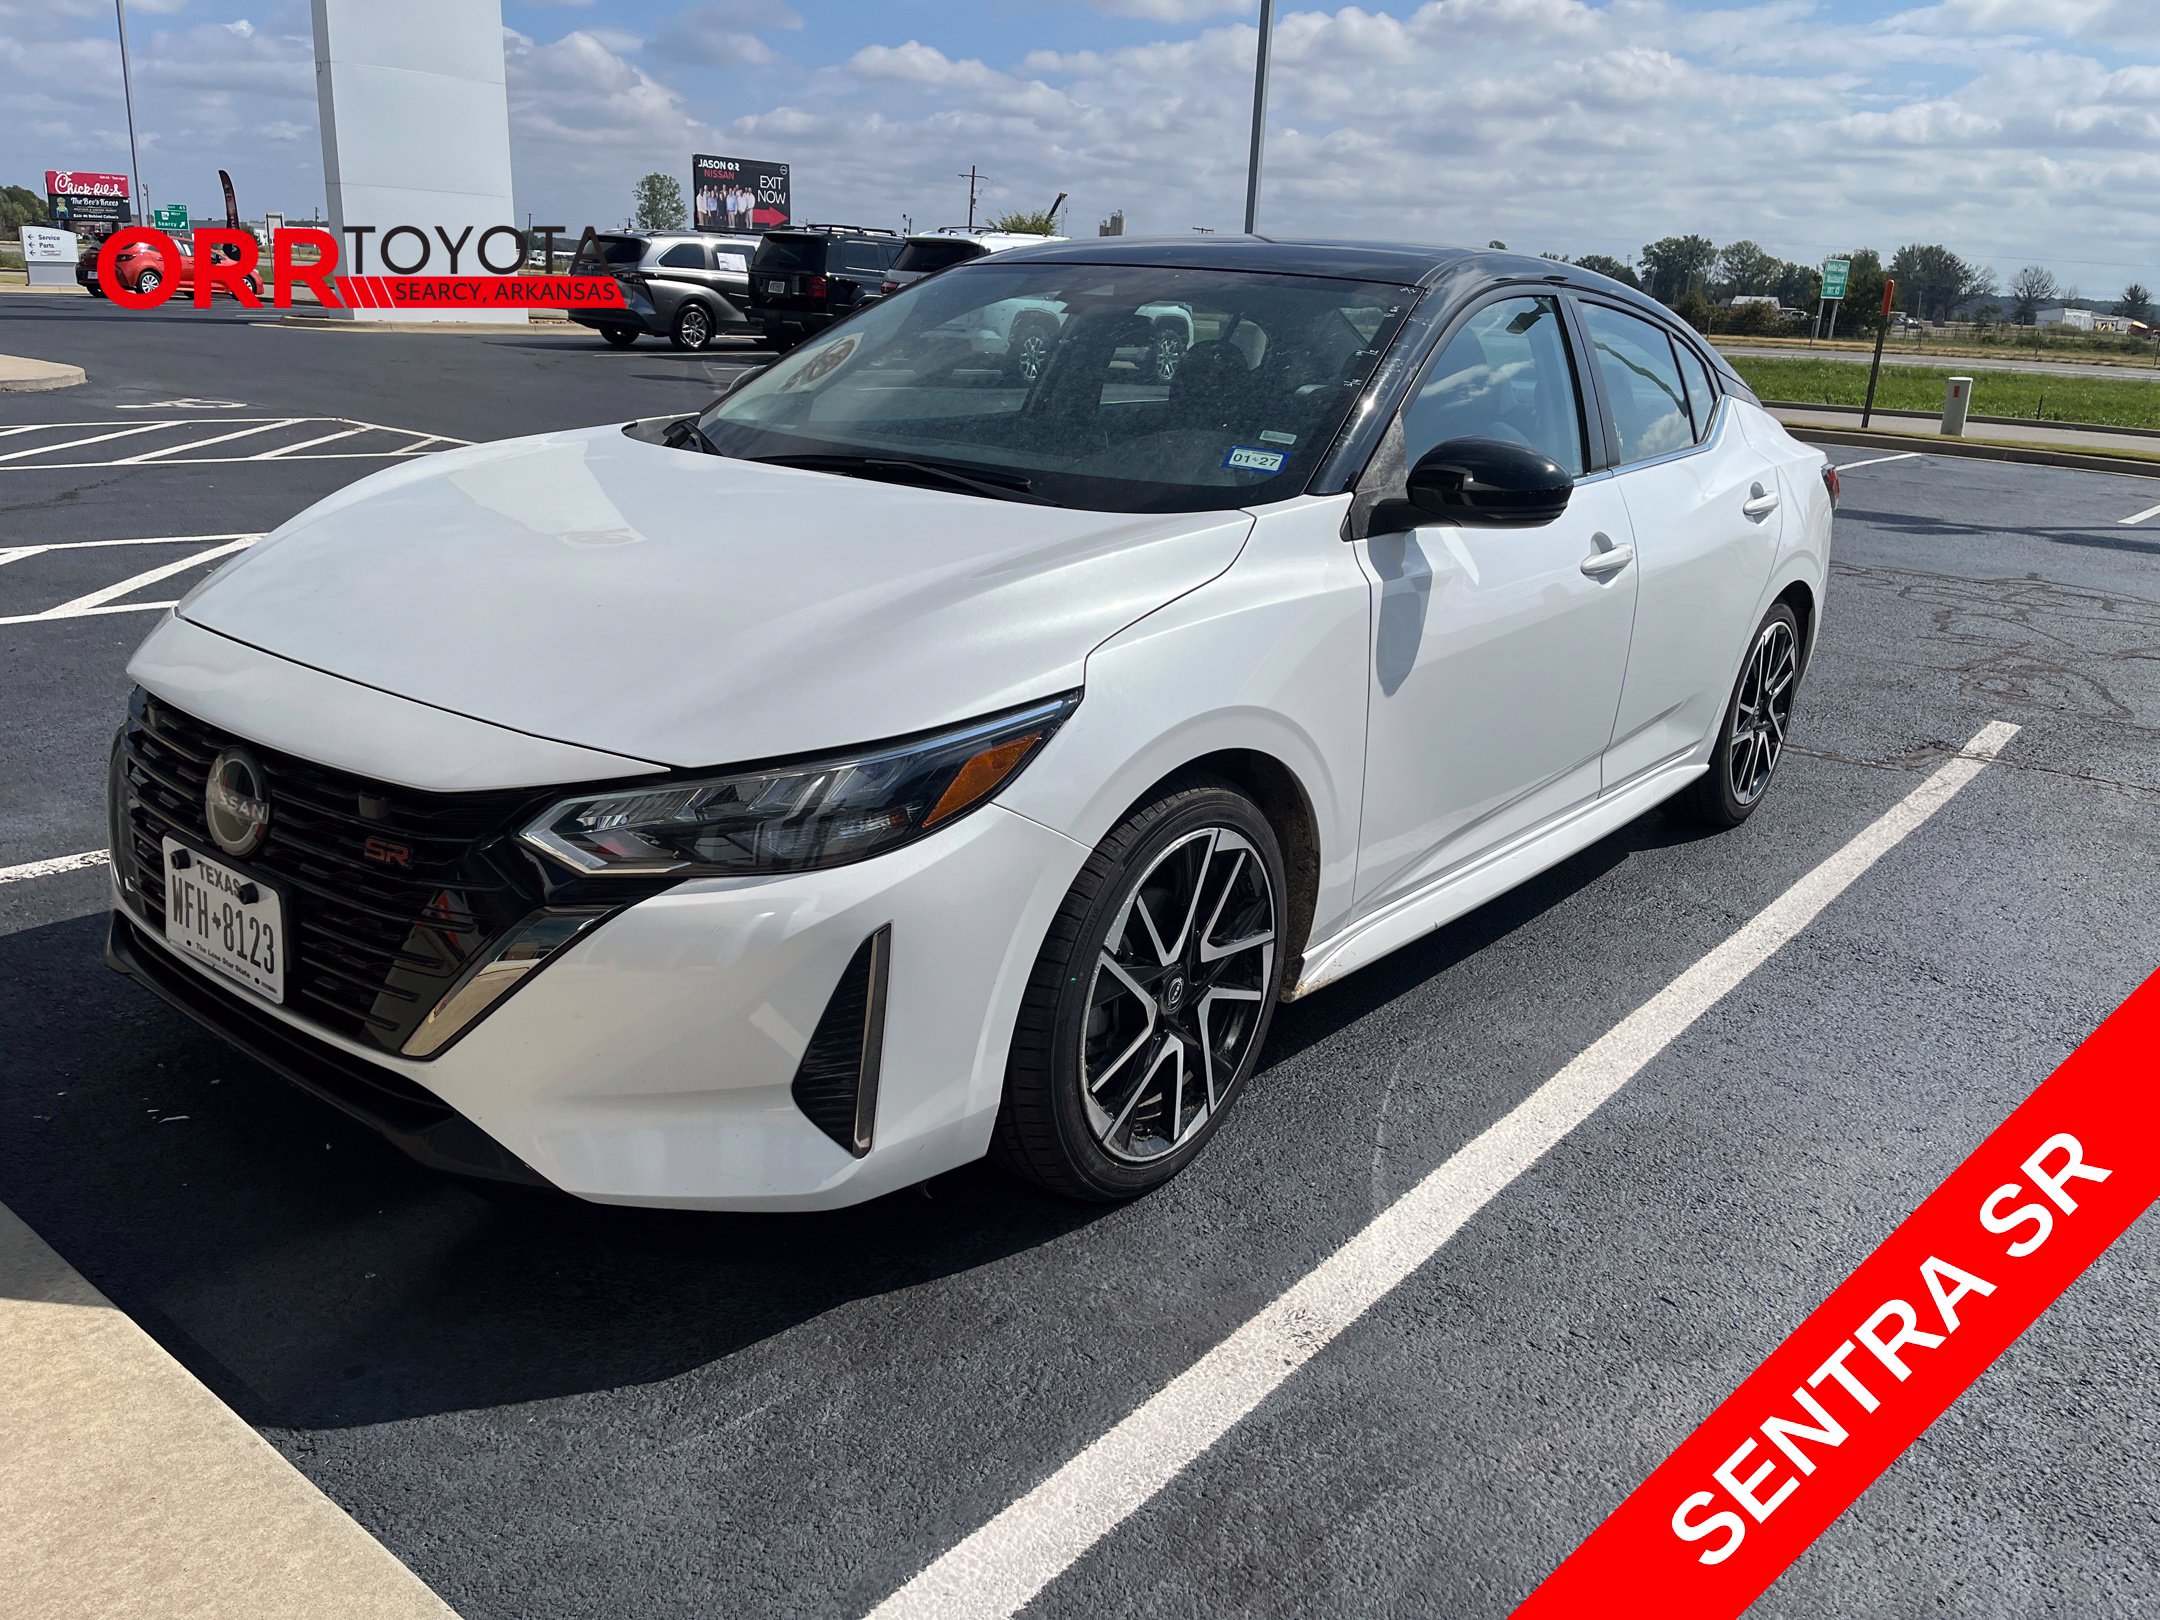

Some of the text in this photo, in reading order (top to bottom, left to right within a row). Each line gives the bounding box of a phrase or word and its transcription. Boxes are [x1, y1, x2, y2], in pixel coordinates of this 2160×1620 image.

[698, 158, 726, 170] JASON
[704, 169, 735, 180] NISSAN
[760, 175, 784, 190] EXIT
[757, 190, 786, 205] NOW
[364, 836, 410, 867] SR
[197, 859, 241, 898] TEXAS
[196, 942, 251, 979] The Lone Star State
